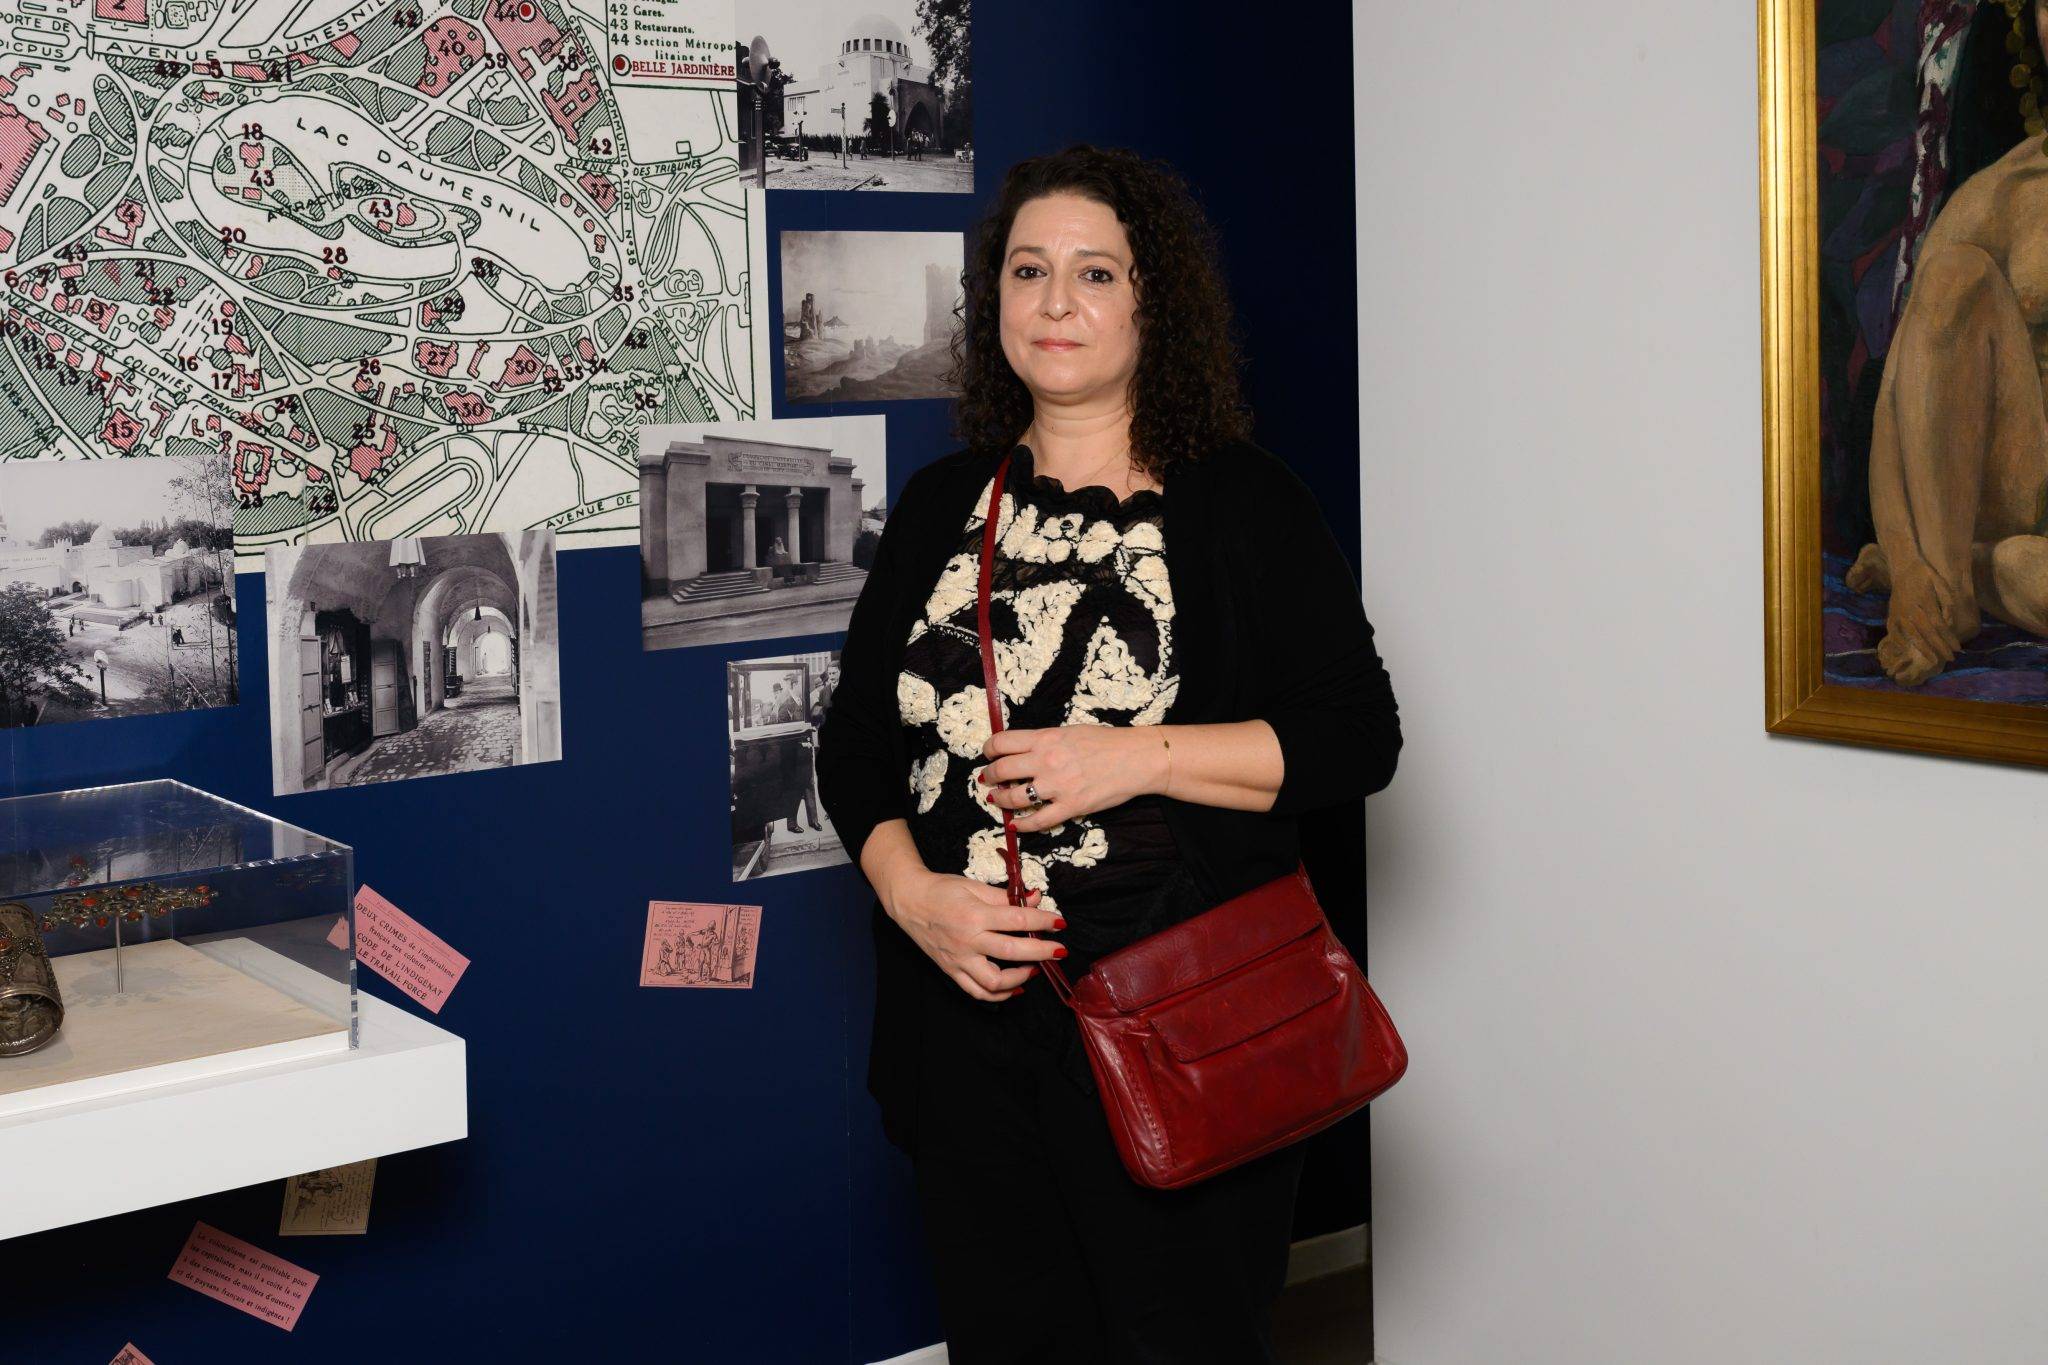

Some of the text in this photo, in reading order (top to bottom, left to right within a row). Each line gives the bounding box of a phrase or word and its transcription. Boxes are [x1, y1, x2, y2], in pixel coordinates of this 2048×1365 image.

[493, 5, 519, 23] 44
[610, 3, 665, 18] 42 Gares.
[52, 20, 70, 33] DE
[106, 0, 386, 61] AVENUE DAUMESNIL
[610, 18, 695, 34] 43 Restaurants.
[611, 33, 629, 46] 44
[635, 34, 679, 48] Section
[655, 49, 712, 62] litaine et
[210, 58, 223, 79] 5
[632, 60, 735, 77] BELLE JARDINIÈRE
[241, 123, 263, 141] 18
[588, 137, 613, 155] 42
[297, 117, 349, 147] LAC
[377, 149, 541, 233] DAUMESNIL
[566, 158, 702, 177] AVENUE DES TRIBUNES
[250, 169, 275, 187] 43
[568, 15, 600, 73] GRANDE
[603, 89, 632, 210] COMMUNICATION
[637, 279, 650, 297] DE
[653, 311, 680, 350] PARIS
[124, 204, 137, 222] 4
[368, 199, 394, 218] 43
[220, 227, 247, 244] 20
[322, 246, 349, 265] 28
[4, 270, 20, 288] 6
[211, 318, 234, 336] 19
[33, 310, 91, 342] AVENUE
[91, 340, 119, 359] DES
[123, 355, 195, 395] COLONIES
[427, 351, 449, 367] 27
[179, 355, 199, 372] 16
[514, 359, 537, 376] 30
[211, 372, 234, 390] 17
[565, 365, 584, 382] 33
[592, 381, 620, 394] PARC
[462, 402, 484, 418] 30
[634, 392, 657, 410] 36
[109, 421, 134, 439] 15
[457, 425, 474, 433] DU
[519, 425, 550, 435] BAC
[546, 494, 633, 530] AVENUE DE
[355, 902, 378, 923] DEUX
[379, 919, 408, 943] CRIMES
[408, 942, 416, 951] de
[357, 932, 379, 951] CODE
[381, 949, 393, 961] DE
[391, 943, 402, 953] aux
[357, 947, 368, 959] LE
[369, 954, 401, 983] TRAVAIL
[185, 1271, 194, 1280] de
[189, 1260, 201, 1269] des
[232, 1278, 241, 1288] de
[291, 1277, 308, 1288] pour
[284, 1286, 291, 1295] la
[292, 1291, 301, 1300] vie
